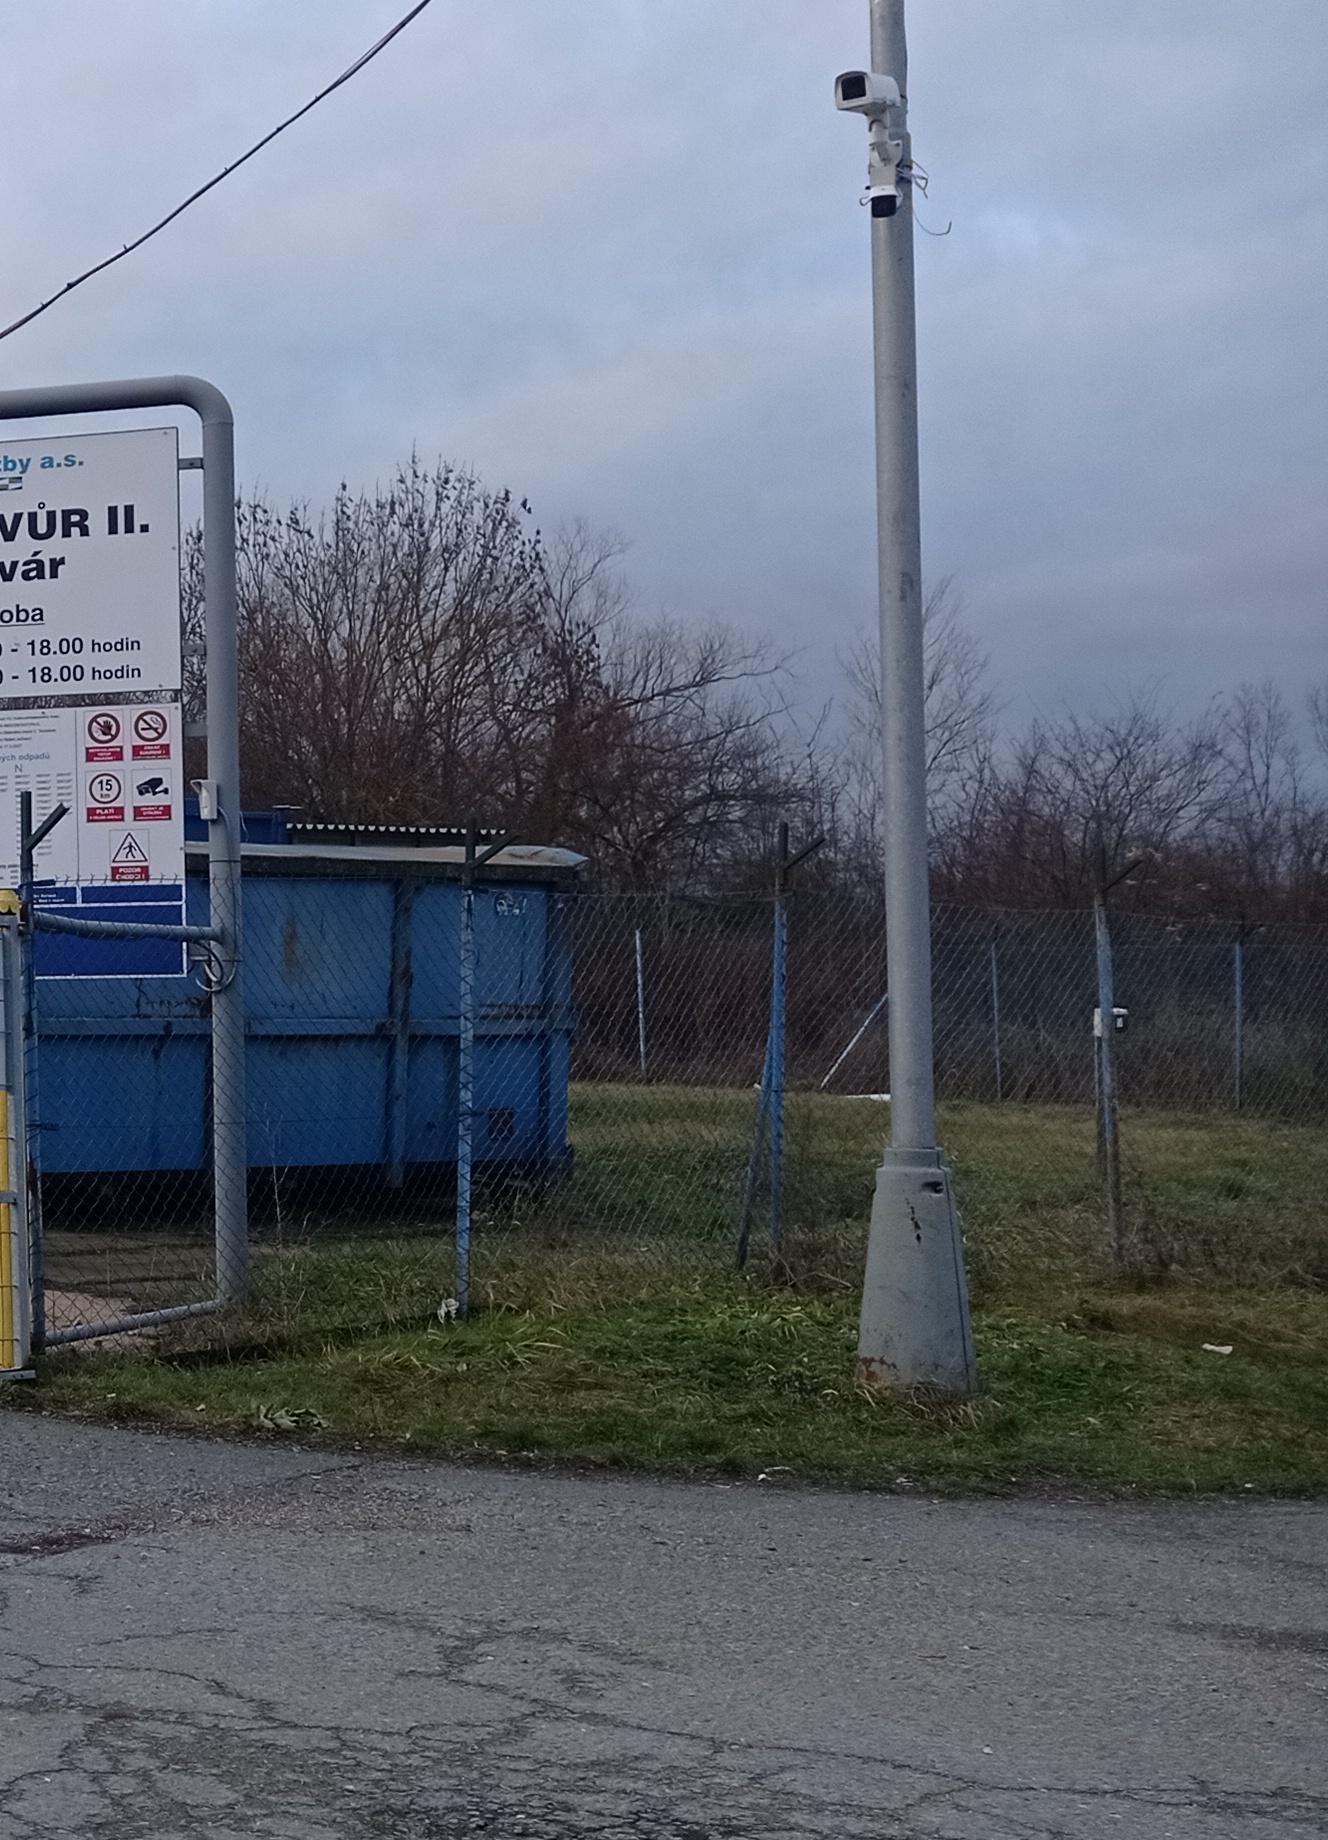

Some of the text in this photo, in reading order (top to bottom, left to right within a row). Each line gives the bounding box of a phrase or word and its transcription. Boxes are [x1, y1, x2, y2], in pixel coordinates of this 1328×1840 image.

[40, 453, 84, 469] a.s.
[107, 504, 150, 535] II.
[27, 637, 84, 656] 18.00
[91, 637, 141, 653] hodin
[28, 665, 85, 684] 18.00
[92, 664, 141, 681] hodin
[19, 752, 50, 762] odpadů
[97, 779, 113, 792] 15
